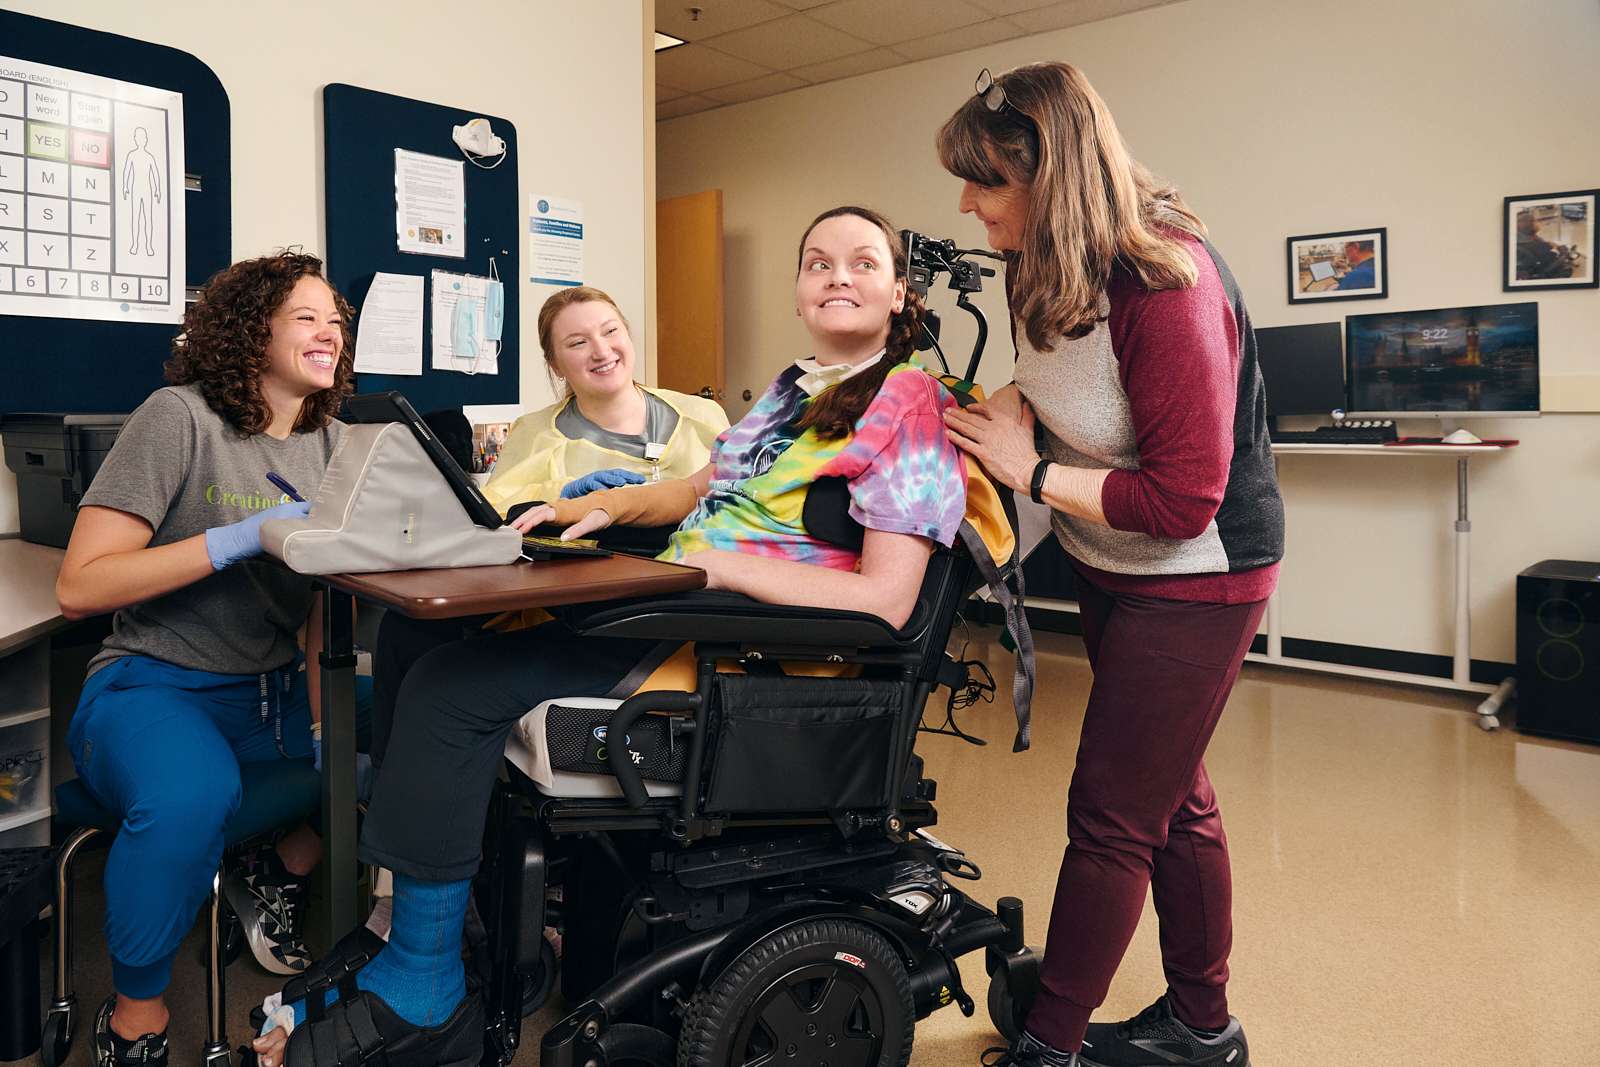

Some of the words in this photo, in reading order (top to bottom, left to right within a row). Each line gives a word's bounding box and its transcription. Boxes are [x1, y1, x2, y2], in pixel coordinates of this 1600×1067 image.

[35, 92, 58, 105] New
[36, 105, 60, 117] word
[34, 133, 62, 149] YES
[81, 143, 100, 154] NO
[42, 171, 55, 185] M
[85, 178, 96, 190] N
[43, 208, 54, 221] S
[86, 213, 97, 225] T
[0, 240, 9, 253] X
[43, 244, 54, 256] Y
[86, 248, 97, 261] Z
[26, 275, 36, 287] 6
[59, 277, 68, 290] 7
[90, 280, 100, 292] 8
[120, 282, 129, 294] 9
[147, 284, 163, 297] 10
[1423, 328, 1449, 340] 9:22
